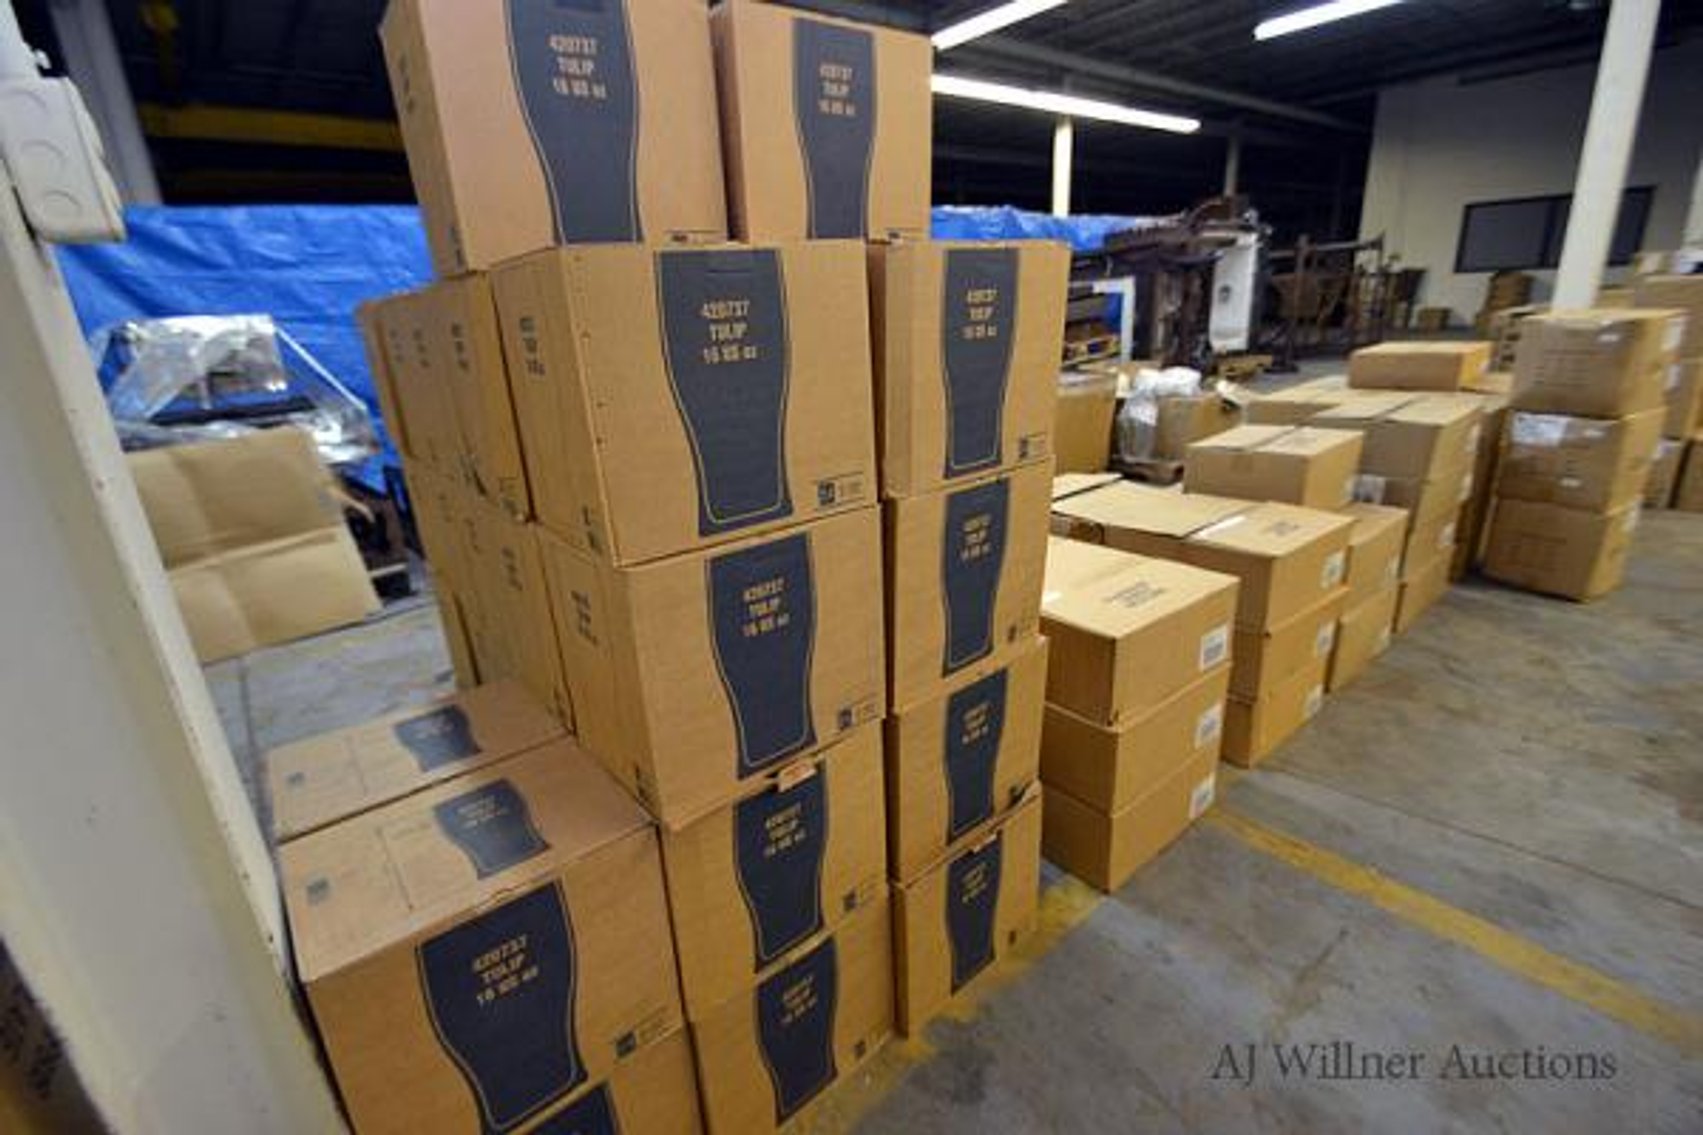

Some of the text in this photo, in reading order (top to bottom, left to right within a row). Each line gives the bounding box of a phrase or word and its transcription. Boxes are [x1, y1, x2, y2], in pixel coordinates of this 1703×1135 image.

[556, 57, 594, 76] TULIP
[709, 322, 747, 341] TULIP
[482, 953, 525, 984] TULIP
